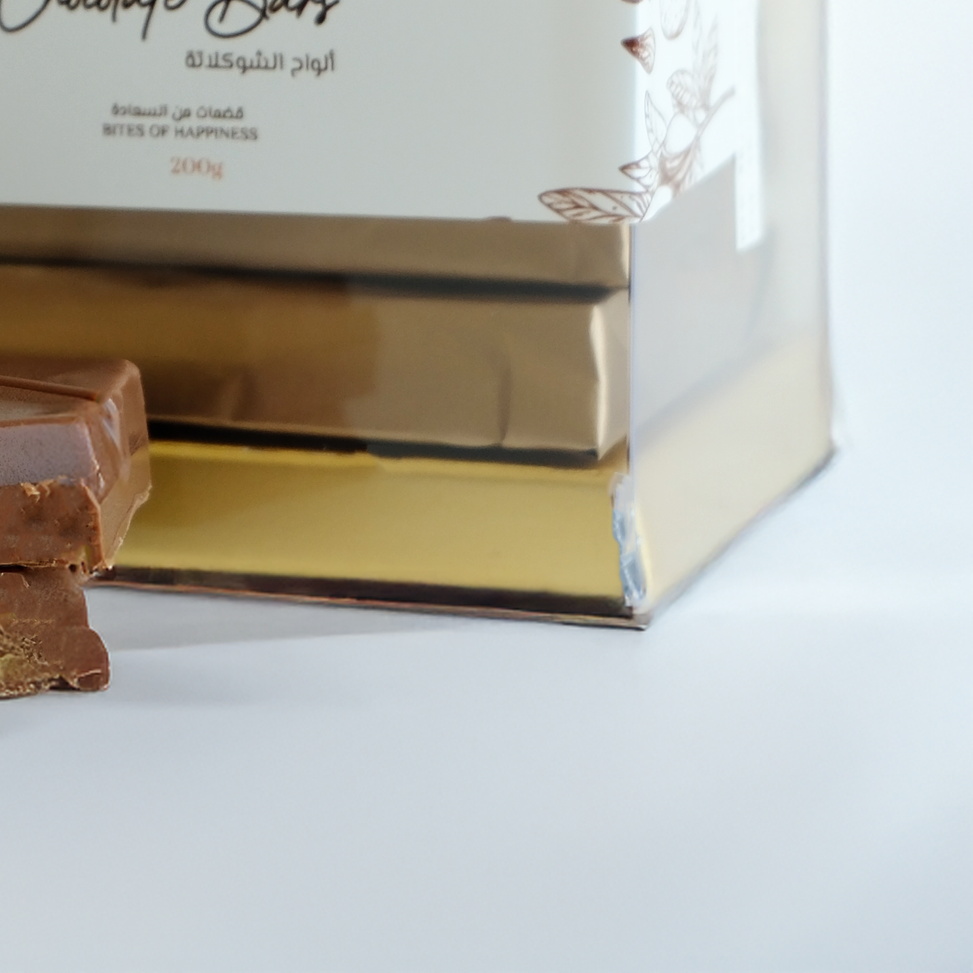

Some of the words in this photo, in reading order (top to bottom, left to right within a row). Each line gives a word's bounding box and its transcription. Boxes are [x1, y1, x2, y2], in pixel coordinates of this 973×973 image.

[185, 50, 284, 75] الشوكلاتة
[291, 49, 336, 77] ألواح
[112, 103, 168, 117] السعادة
[172, 106, 191, 121] من
[102, 123, 145, 138] BITES
[149, 124, 170, 138] OF
[174, 126, 259, 141] HAPPINESS
[171, 157, 224, 180] 200g
